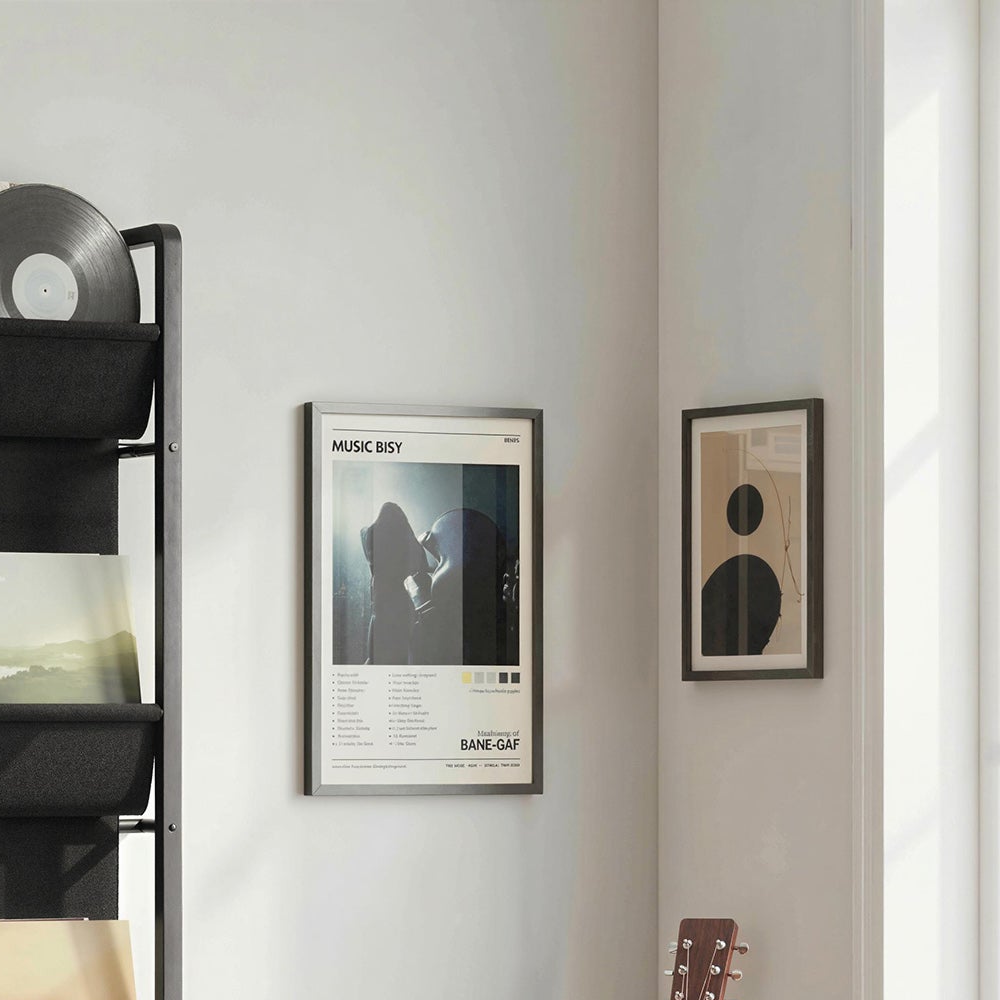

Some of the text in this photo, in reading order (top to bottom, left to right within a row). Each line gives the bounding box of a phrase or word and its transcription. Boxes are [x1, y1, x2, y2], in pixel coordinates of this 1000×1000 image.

[331, 440, 403, 454] MUSIC BISY
[460, 738, 520, 751] BANE-GAF
